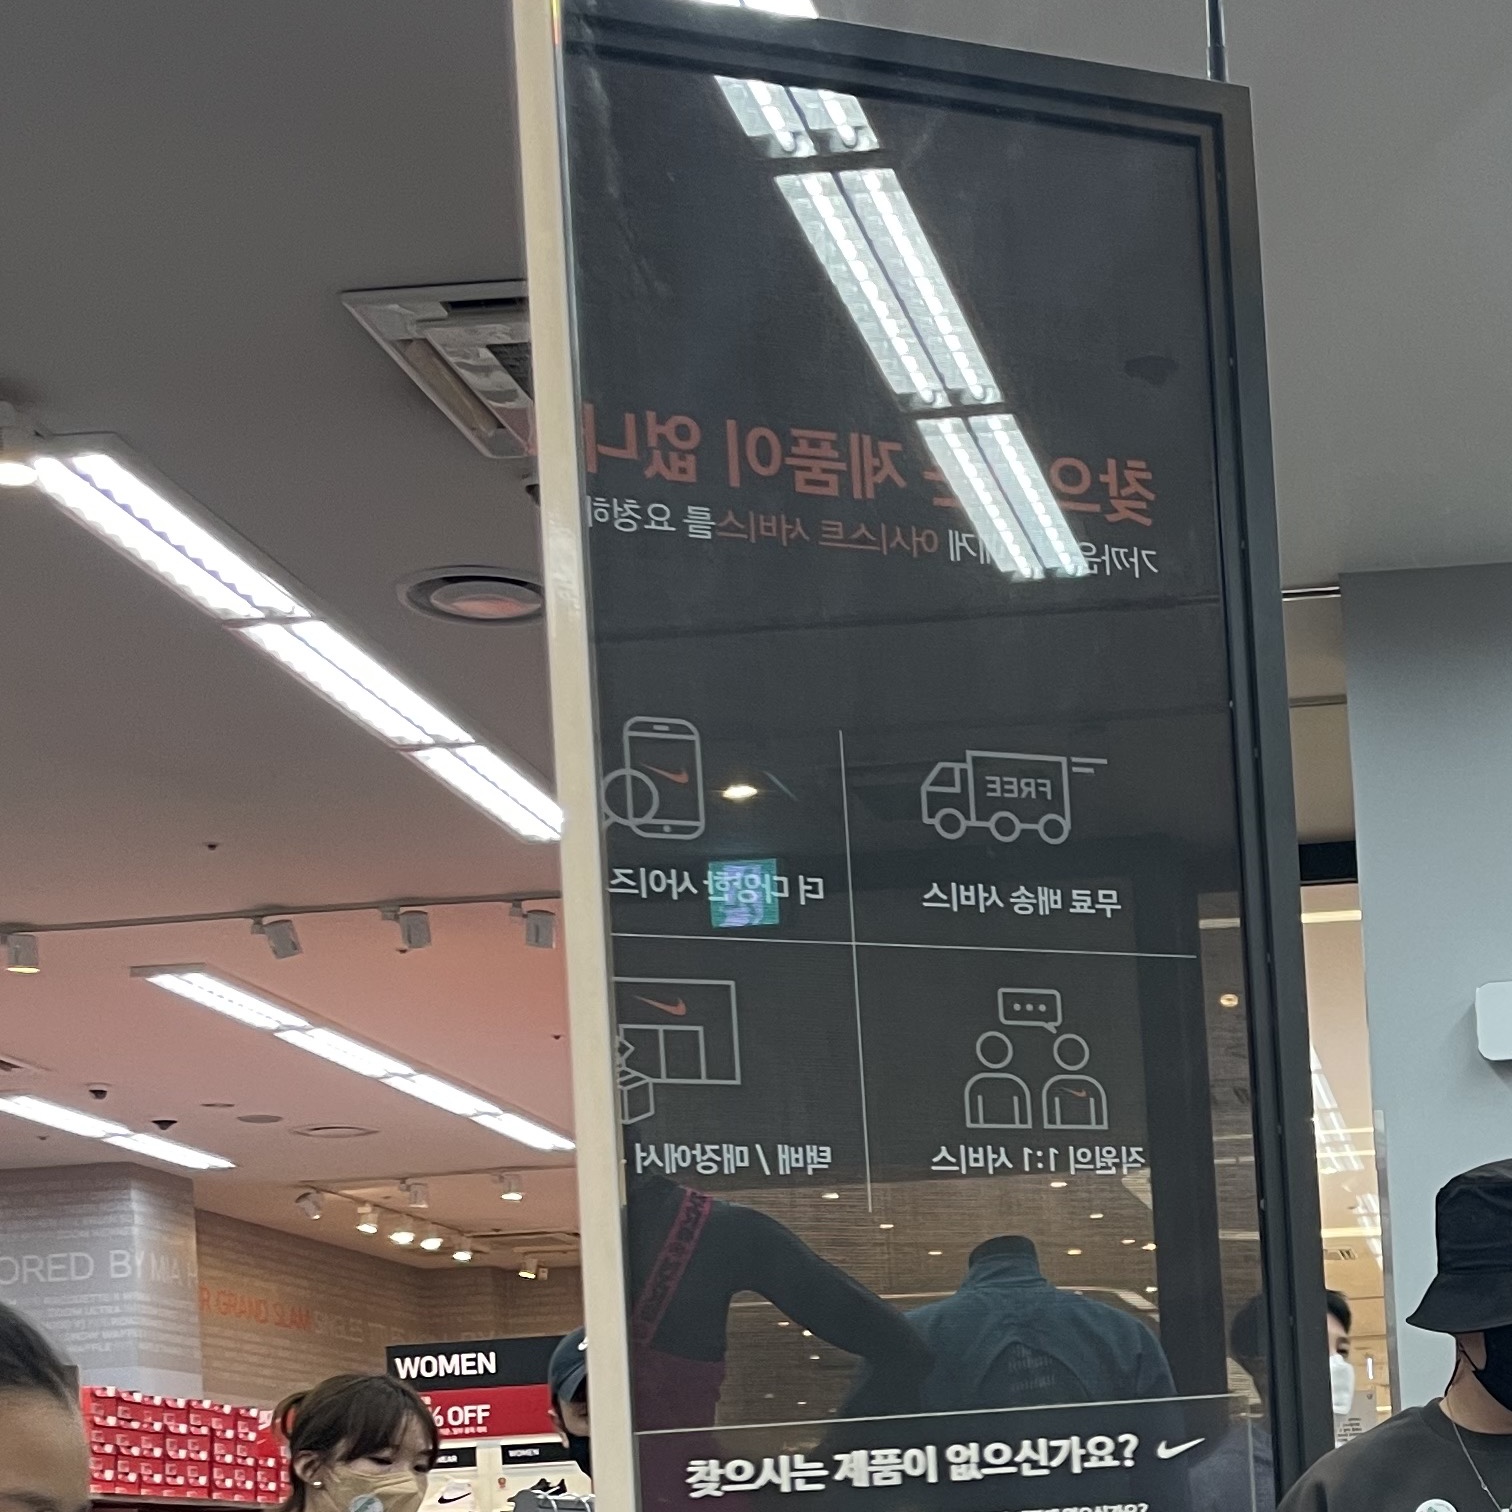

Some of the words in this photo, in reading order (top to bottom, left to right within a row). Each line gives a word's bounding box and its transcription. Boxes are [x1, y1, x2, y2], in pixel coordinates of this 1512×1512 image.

[109, 1250, 144, 1279] BY
[394, 1351, 497, 1380] WOMEN
[447, 1404, 491, 1426] OFF
[685, 1454, 829, 1499] 찾으시는
[833, 1445, 938, 1488] 제품이
[945, 1433, 1140, 1482] 없으신가요?
